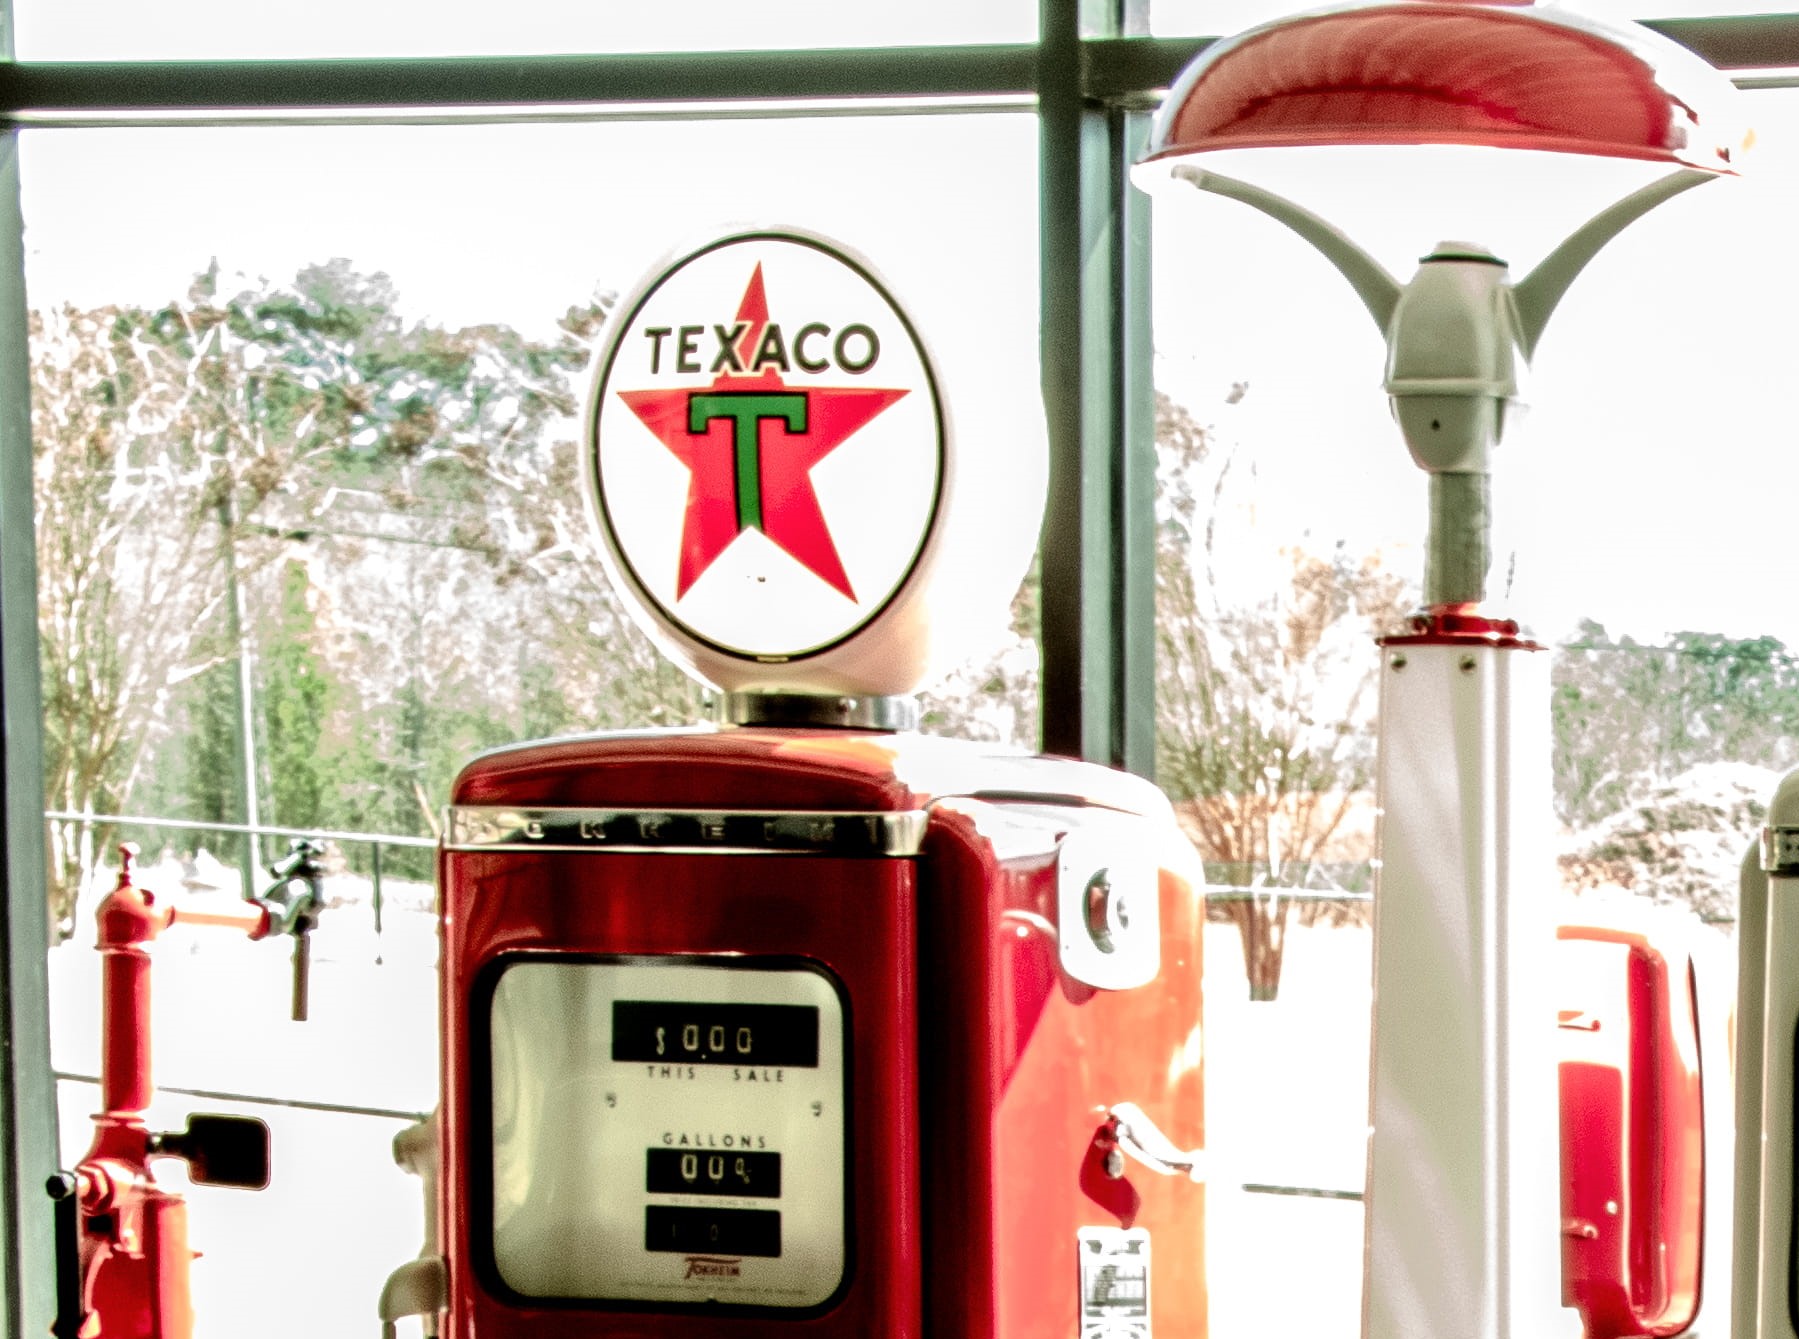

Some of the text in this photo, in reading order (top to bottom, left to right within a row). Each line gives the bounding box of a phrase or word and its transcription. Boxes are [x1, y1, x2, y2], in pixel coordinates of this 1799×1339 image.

[643, 321, 881, 376] TEXACO
[647, 1066, 784, 1082] THIS SALE
[662, 1132, 766, 1149] GALLONS
